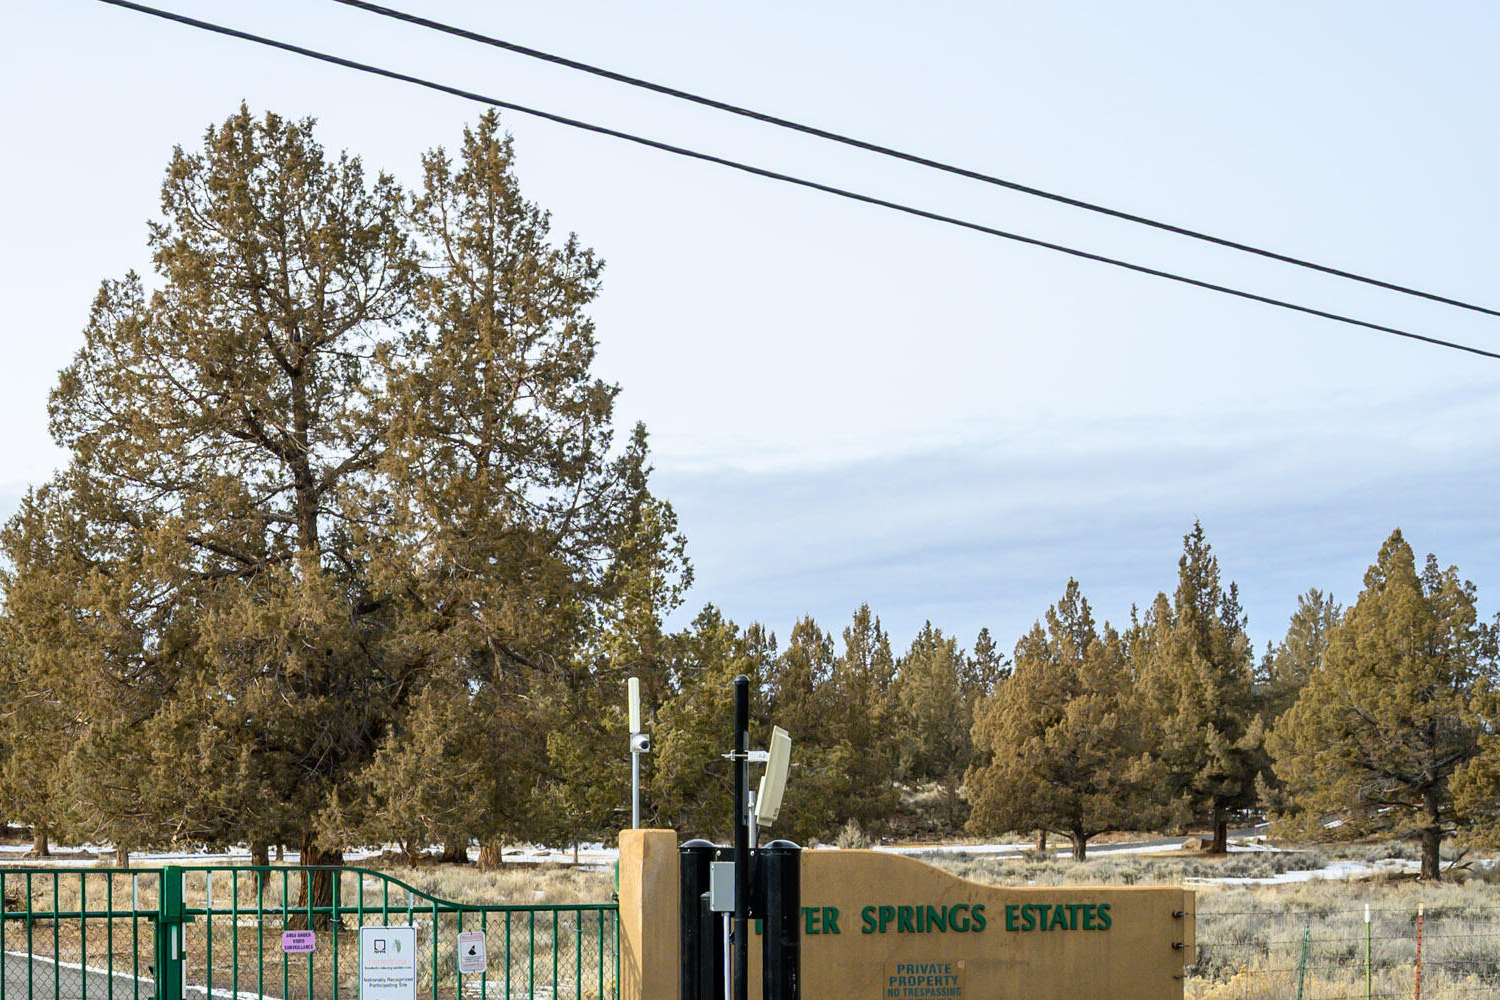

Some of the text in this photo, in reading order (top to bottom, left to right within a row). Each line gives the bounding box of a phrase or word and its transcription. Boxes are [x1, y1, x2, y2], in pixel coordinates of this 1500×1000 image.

[861, 903, 987, 934] SPRINGS
[1005, 903, 1112, 932] ESTATES
[897, 962, 952, 975] PRIVATE
[888, 974, 959, 987] PROPERTY
[887, 986, 962, 998] NO TRESPASSING
